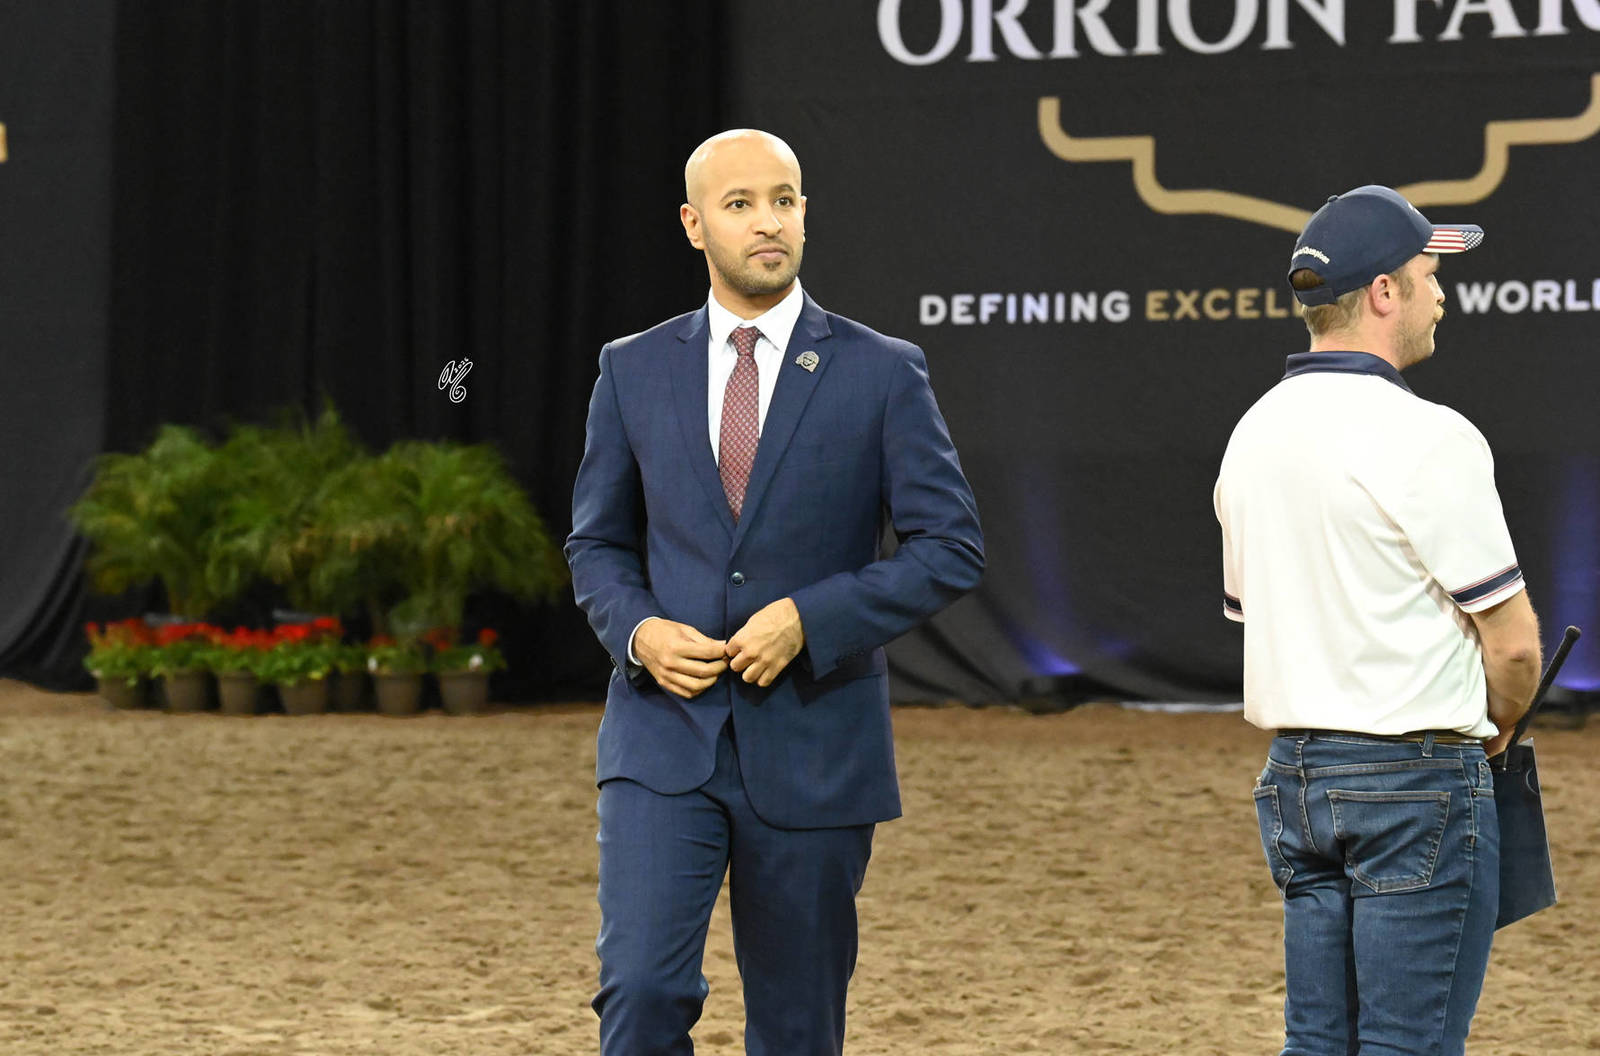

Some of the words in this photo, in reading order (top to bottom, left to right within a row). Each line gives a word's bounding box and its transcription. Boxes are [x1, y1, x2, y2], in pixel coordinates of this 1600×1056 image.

[877, 0, 1346, 66] ORRION
[919, 290, 1131, 326] DEFINING
[1456, 277, 1600, 314] WORL
